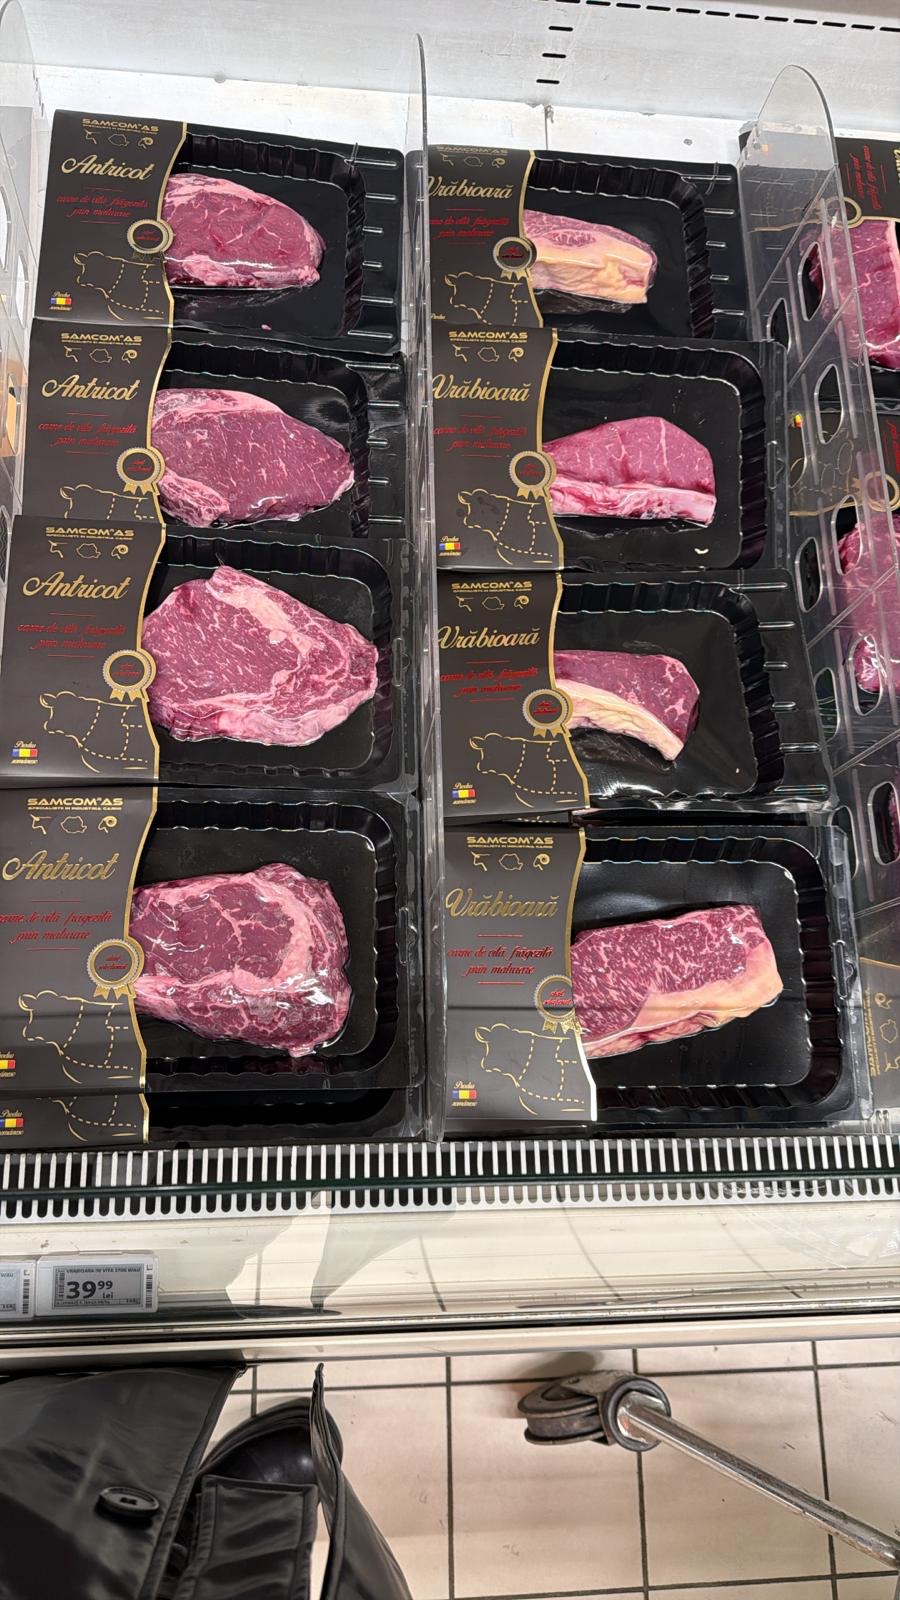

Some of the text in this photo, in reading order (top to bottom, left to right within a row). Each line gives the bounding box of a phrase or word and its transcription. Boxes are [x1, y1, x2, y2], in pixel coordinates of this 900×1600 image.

[61, 154, 155, 180] Antricot
[41, 374, 141, 401] Antricot
[431, 374, 531, 401] Vrăbioară
[22, 571, 131, 599] Antricot
[437, 626, 541, 649] Vrăbioară
[2, 849, 120, 880] Antricot
[445, 888, 560, 917] Vrăbioară
[66, 1280, 113, 1299] 39 99
